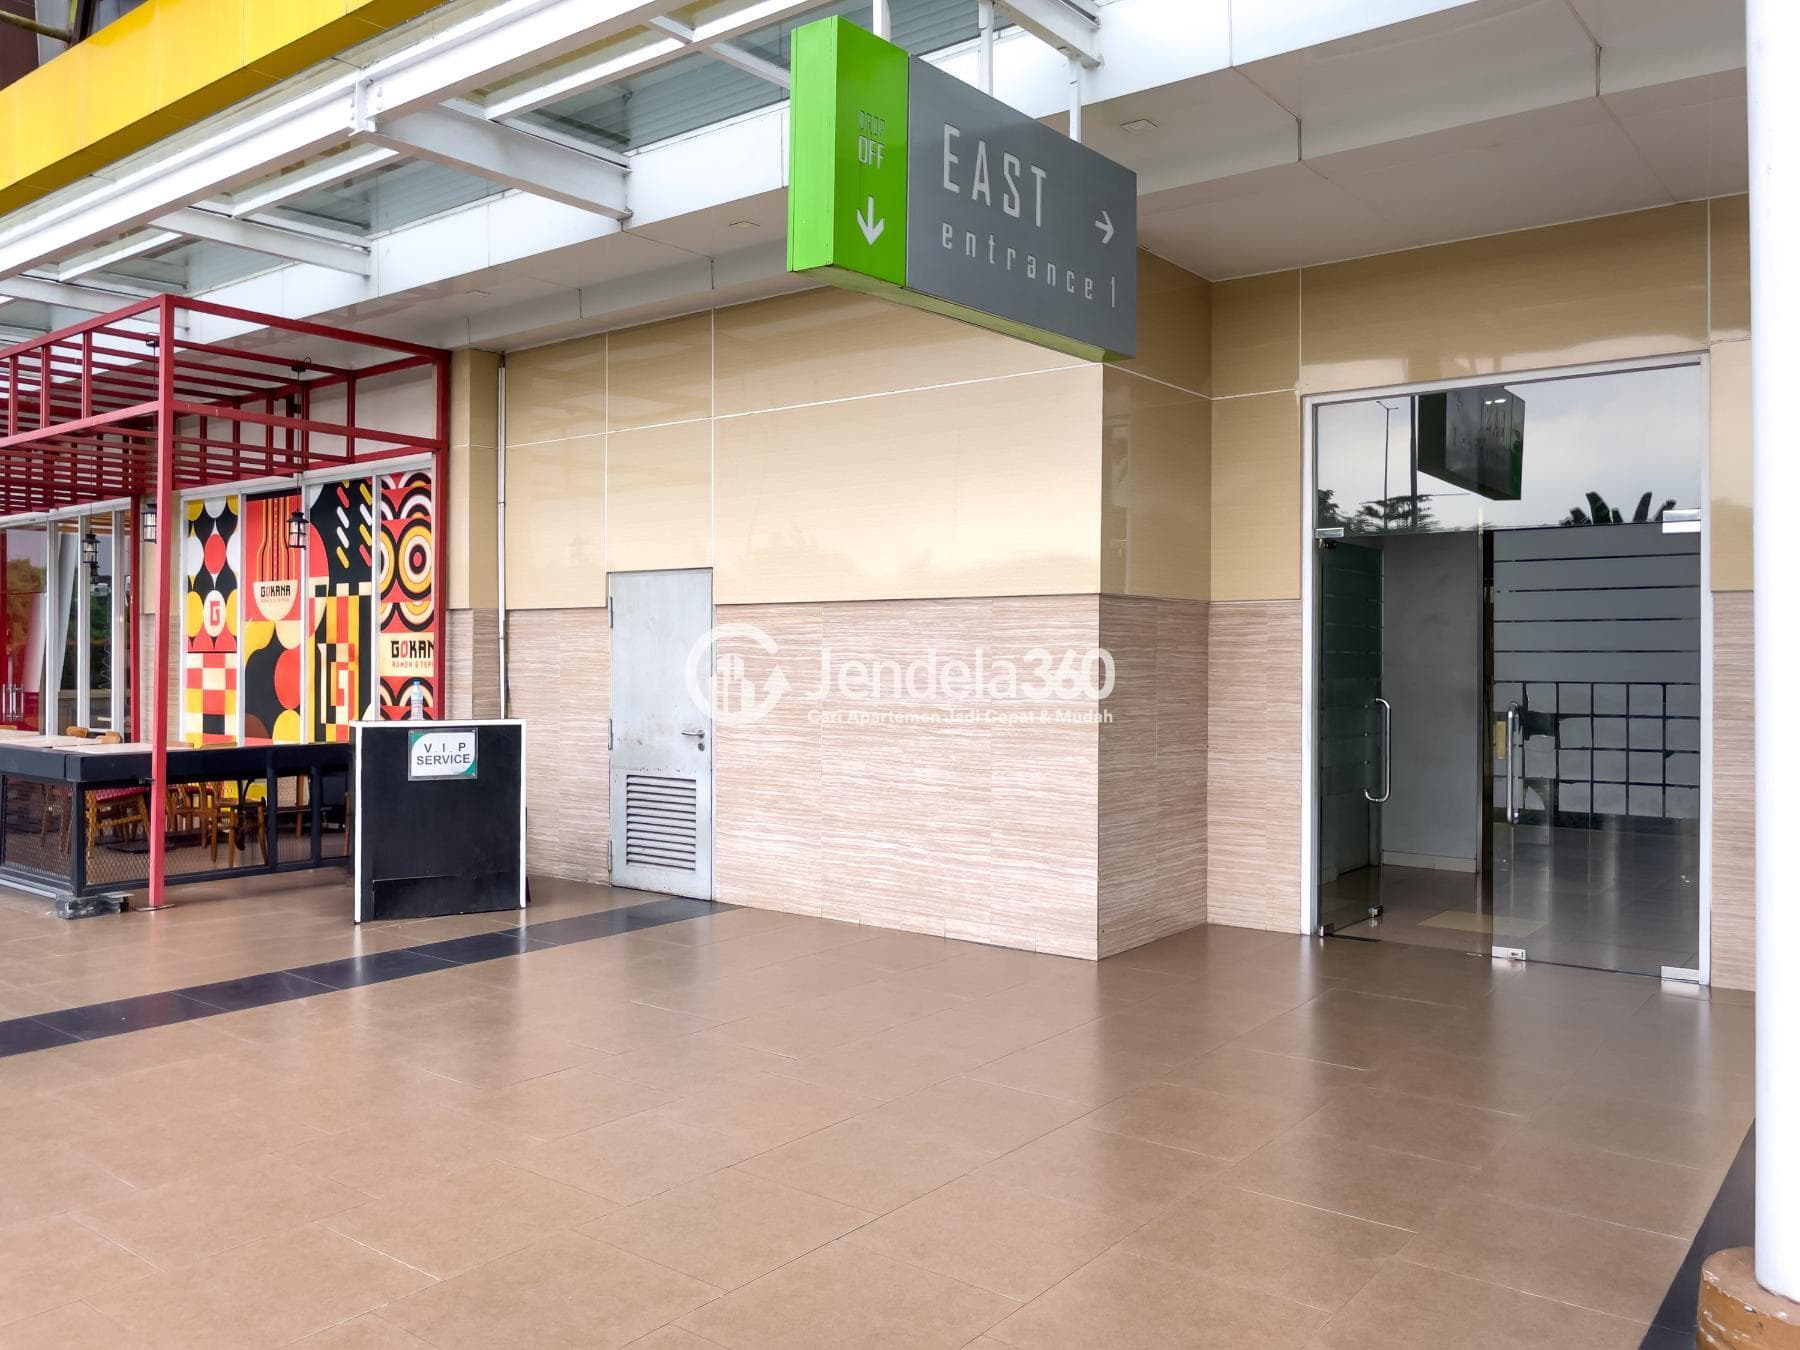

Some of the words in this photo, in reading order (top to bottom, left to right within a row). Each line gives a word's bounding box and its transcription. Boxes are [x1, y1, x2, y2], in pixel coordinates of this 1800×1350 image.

[858, 134, 886, 169] OFF
[943, 121, 1047, 228] EAST
[942, 222, 1093, 300] entrance
[260, 584, 291, 598] GOKANA
[210, 601, 220, 626] G
[392, 660, 413, 669] RAMEN
[416, 753, 471, 766] SERVICE
